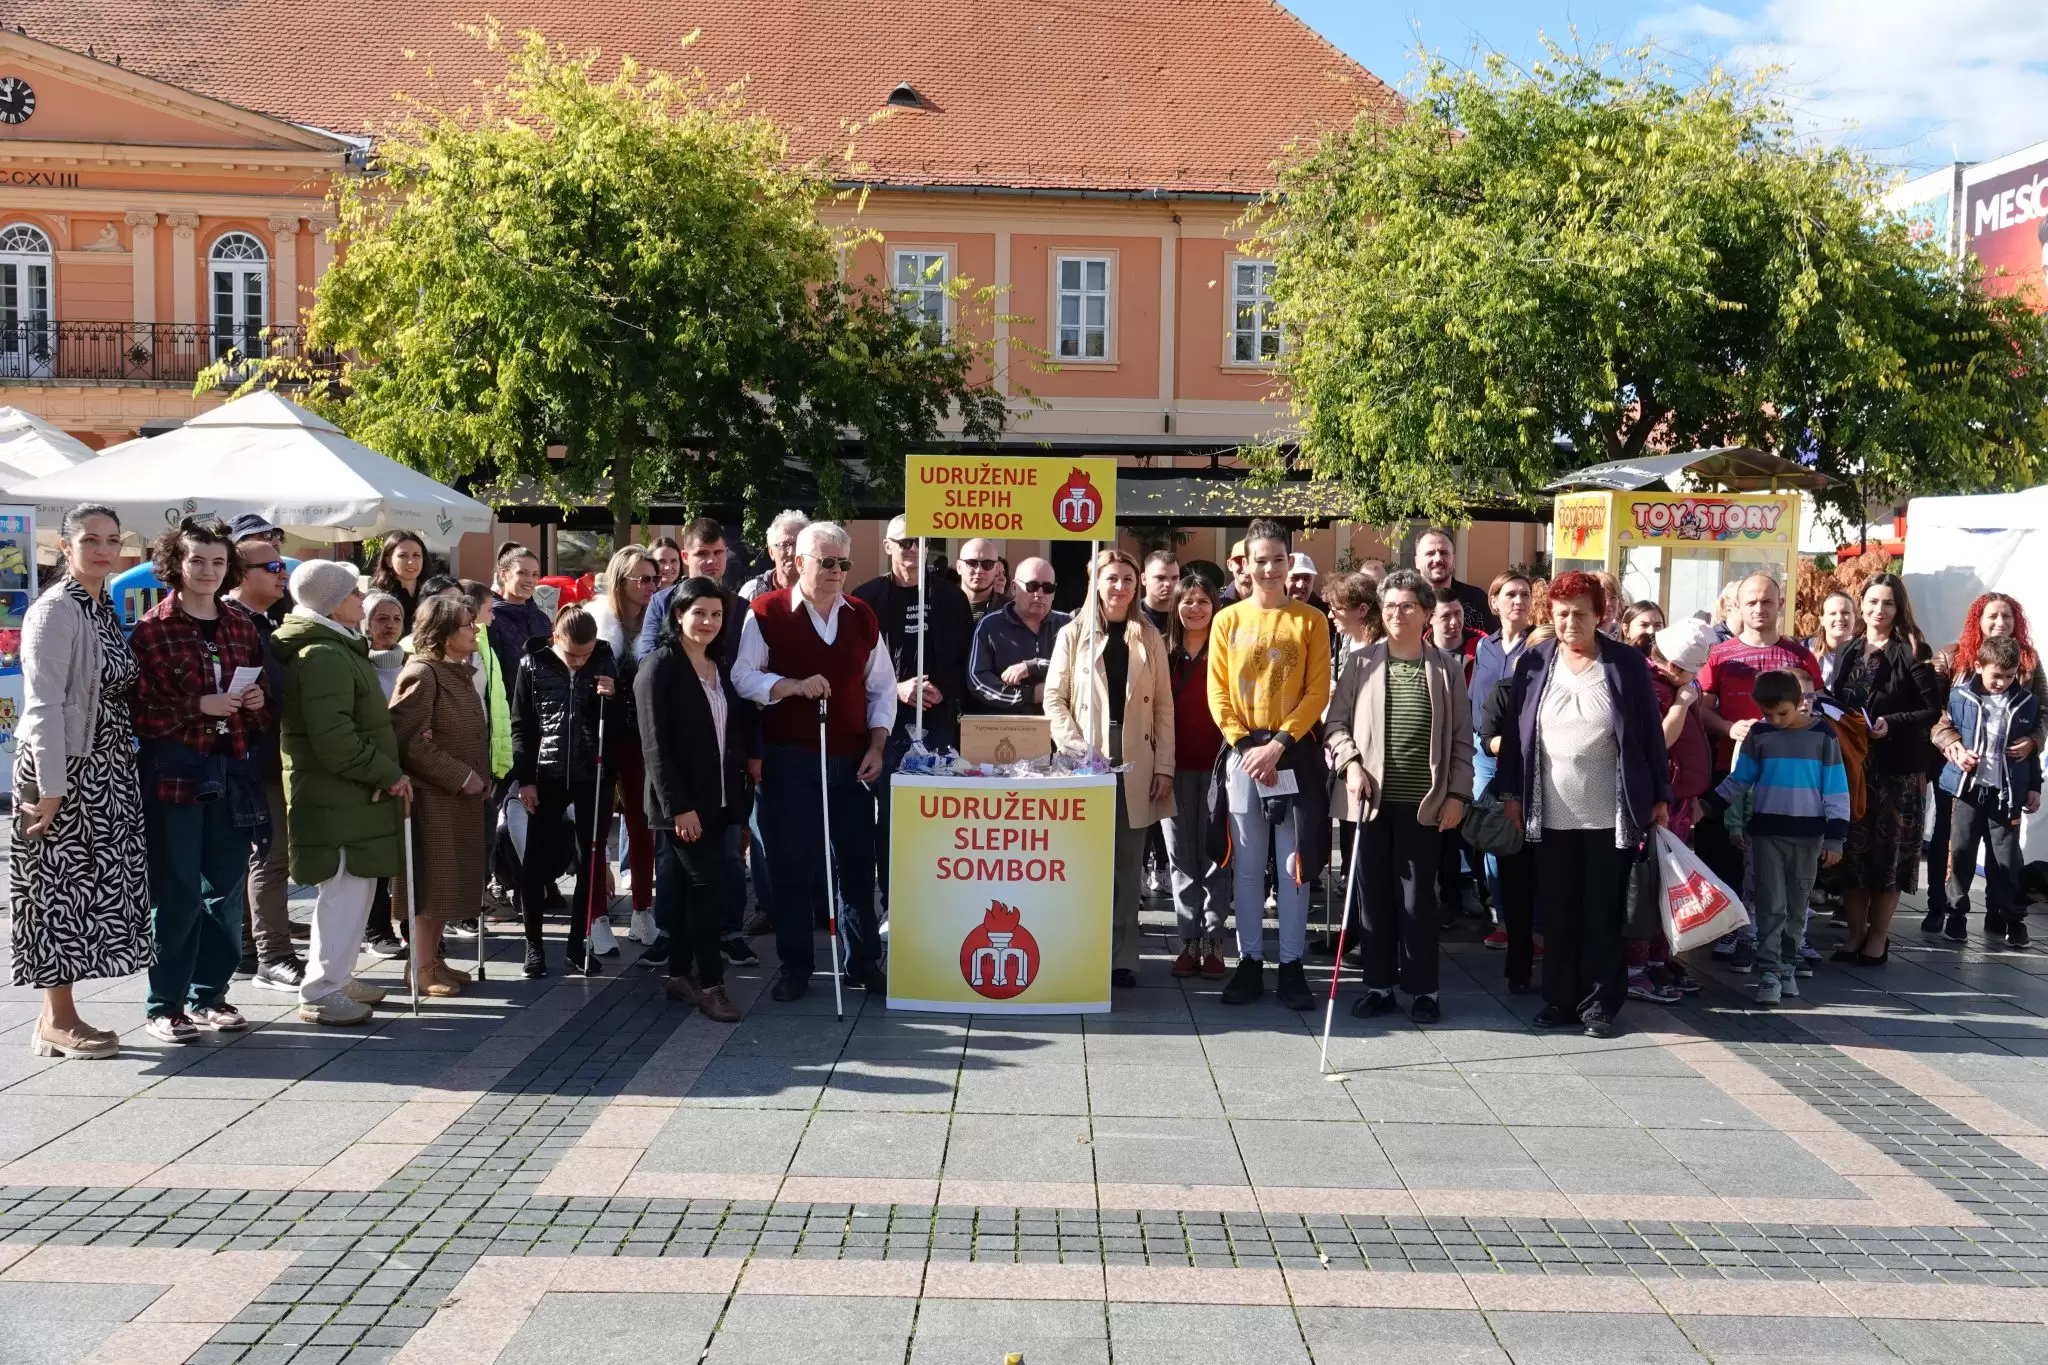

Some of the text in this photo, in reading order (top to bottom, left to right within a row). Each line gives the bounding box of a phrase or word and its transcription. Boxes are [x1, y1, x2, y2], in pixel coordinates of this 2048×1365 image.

[920, 462, 1038, 486] UDRUŽENJE
[944, 489, 1012, 508] SLEPIH
[932, 511, 1024, 531] SOMBOR
[1559, 505, 1606, 530] TOY STORY
[1632, 503, 1687, 530] TOY
[1693, 504, 1781, 532] STORY
[920, 791, 1087, 821] UDRUŽENJE
[954, 826, 1049, 851] SLEPIH
[936, 856, 1067, 882] SOMBOR
